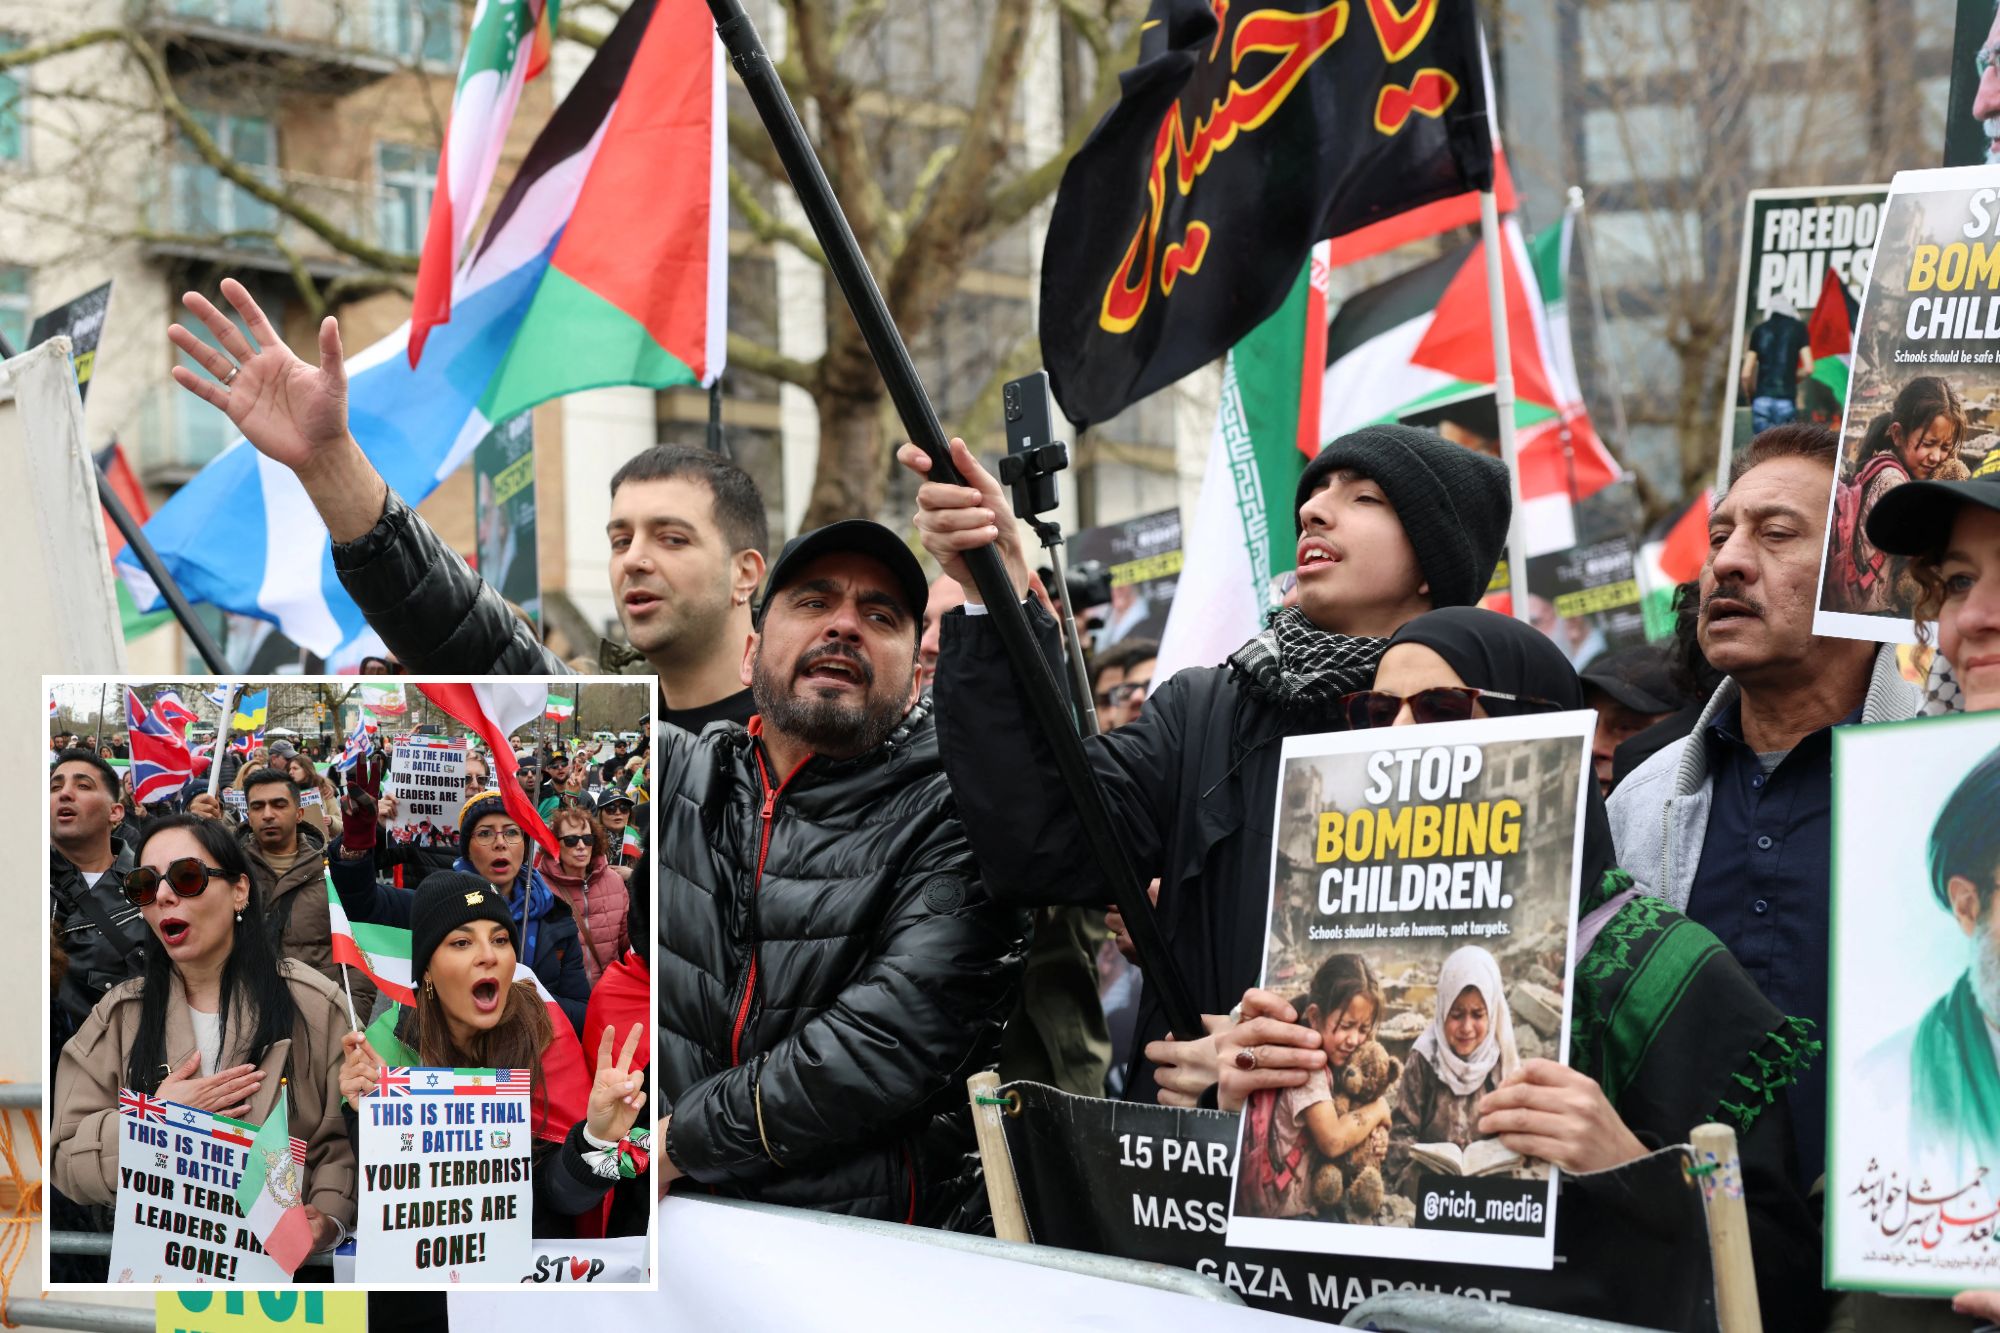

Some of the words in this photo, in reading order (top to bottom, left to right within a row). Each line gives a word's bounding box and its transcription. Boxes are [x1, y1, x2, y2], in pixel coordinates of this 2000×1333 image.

[1762, 203, 1888, 251] FREEDO
[1963, 188, 2000, 239] S
[1894, 350, 1927, 363] Schools
[1929, 350, 1959, 363] should
[1961, 350, 1972, 363] be
[1974, 350, 1994, 363] safe
[396, 748, 411, 759] THIS
[413, 749, 420, 760] IS
[423, 750, 437, 761] THE
[440, 751, 463, 763] FINAL
[412, 761, 440, 772] BATTLE
[392, 772, 411, 784] YOUR
[415, 774, 465, 788] TERRORIST
[1364, 745, 1483, 804] STOP
[396, 788, 435, 800] LEADERS
[439, 791, 457, 802] ARE
[410, 803, 442, 815] GONE!
[1316, 799, 1522, 864] BOMBING
[1318, 861, 1513, 915] CHILDREN.
[1308, 925, 1343, 940] Schools
[1344, 924, 1375, 939] should
[1376, 924, 1388, 938] be
[1390, 922, 1410, 938] safe
[1411, 922, 1449, 939] havens,
[1451, 921, 1468, 936] not
[1470, 920, 1511, 939] targets.
[370, 1103, 413, 1126] THIS
[420, 1103, 438, 1126] IS
[444, 1103, 475, 1125] THE
[481, 1102, 526, 1124] FINAL
[128, 1121, 168, 1149] THIS
[175, 1134, 193, 1156] IS
[201, 1141, 234, 1167] THE
[422, 1129, 483, 1153] BATTLE
[1118, 1133, 1153, 1169] 15
[120, 1166, 174, 1200] YOUR
[183, 1183, 246, 1219] TERR
[365, 1162, 421, 1192] YOUR
[429, 1157, 531, 1188] TERRORIST
[135, 1202, 227, 1245] LEADERS
[382, 1197, 473, 1231] LEADERS
[481, 1194, 517, 1222] ARE
[1132, 1193, 1228, 1235] MASS
[1423, 1190, 1544, 1224] @rich_media
[164, 1241, 238, 1282] GONE!
[415, 1232, 486, 1269] GONE!
[1196, 1258, 1293, 1301] GAZA
